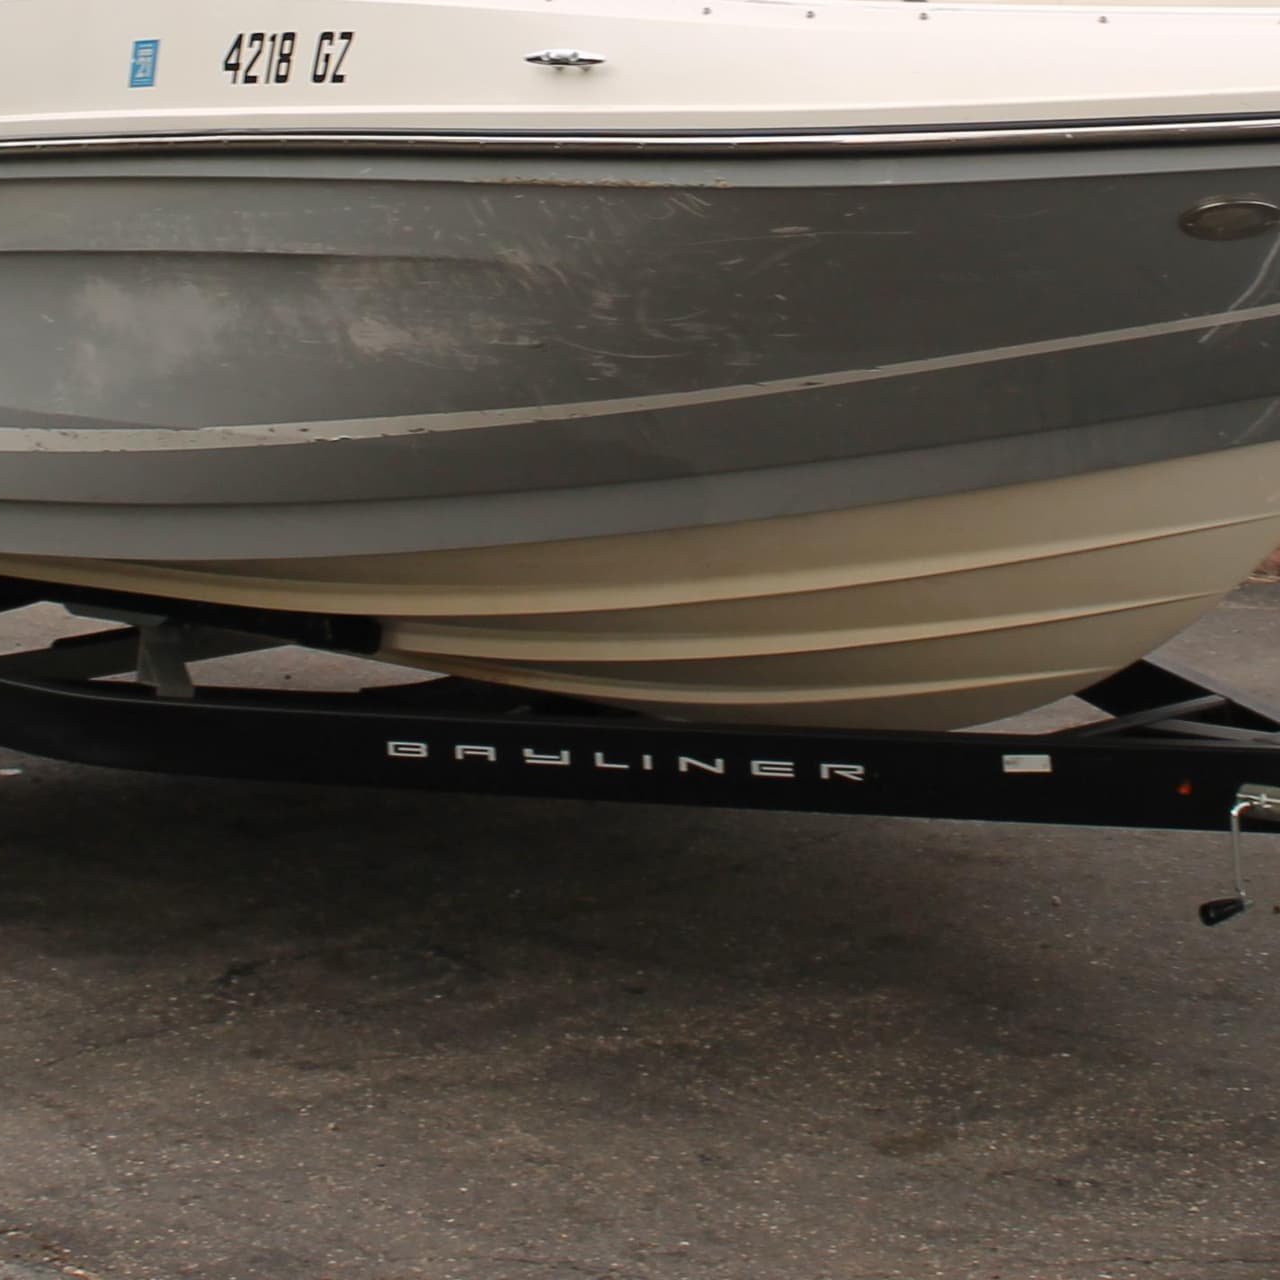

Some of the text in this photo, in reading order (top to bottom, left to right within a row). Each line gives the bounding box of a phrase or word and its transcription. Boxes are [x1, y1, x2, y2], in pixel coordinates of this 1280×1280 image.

[223, 31, 354, 84] 4218 GZ
[387, 741, 865, 781] BAYLINER
